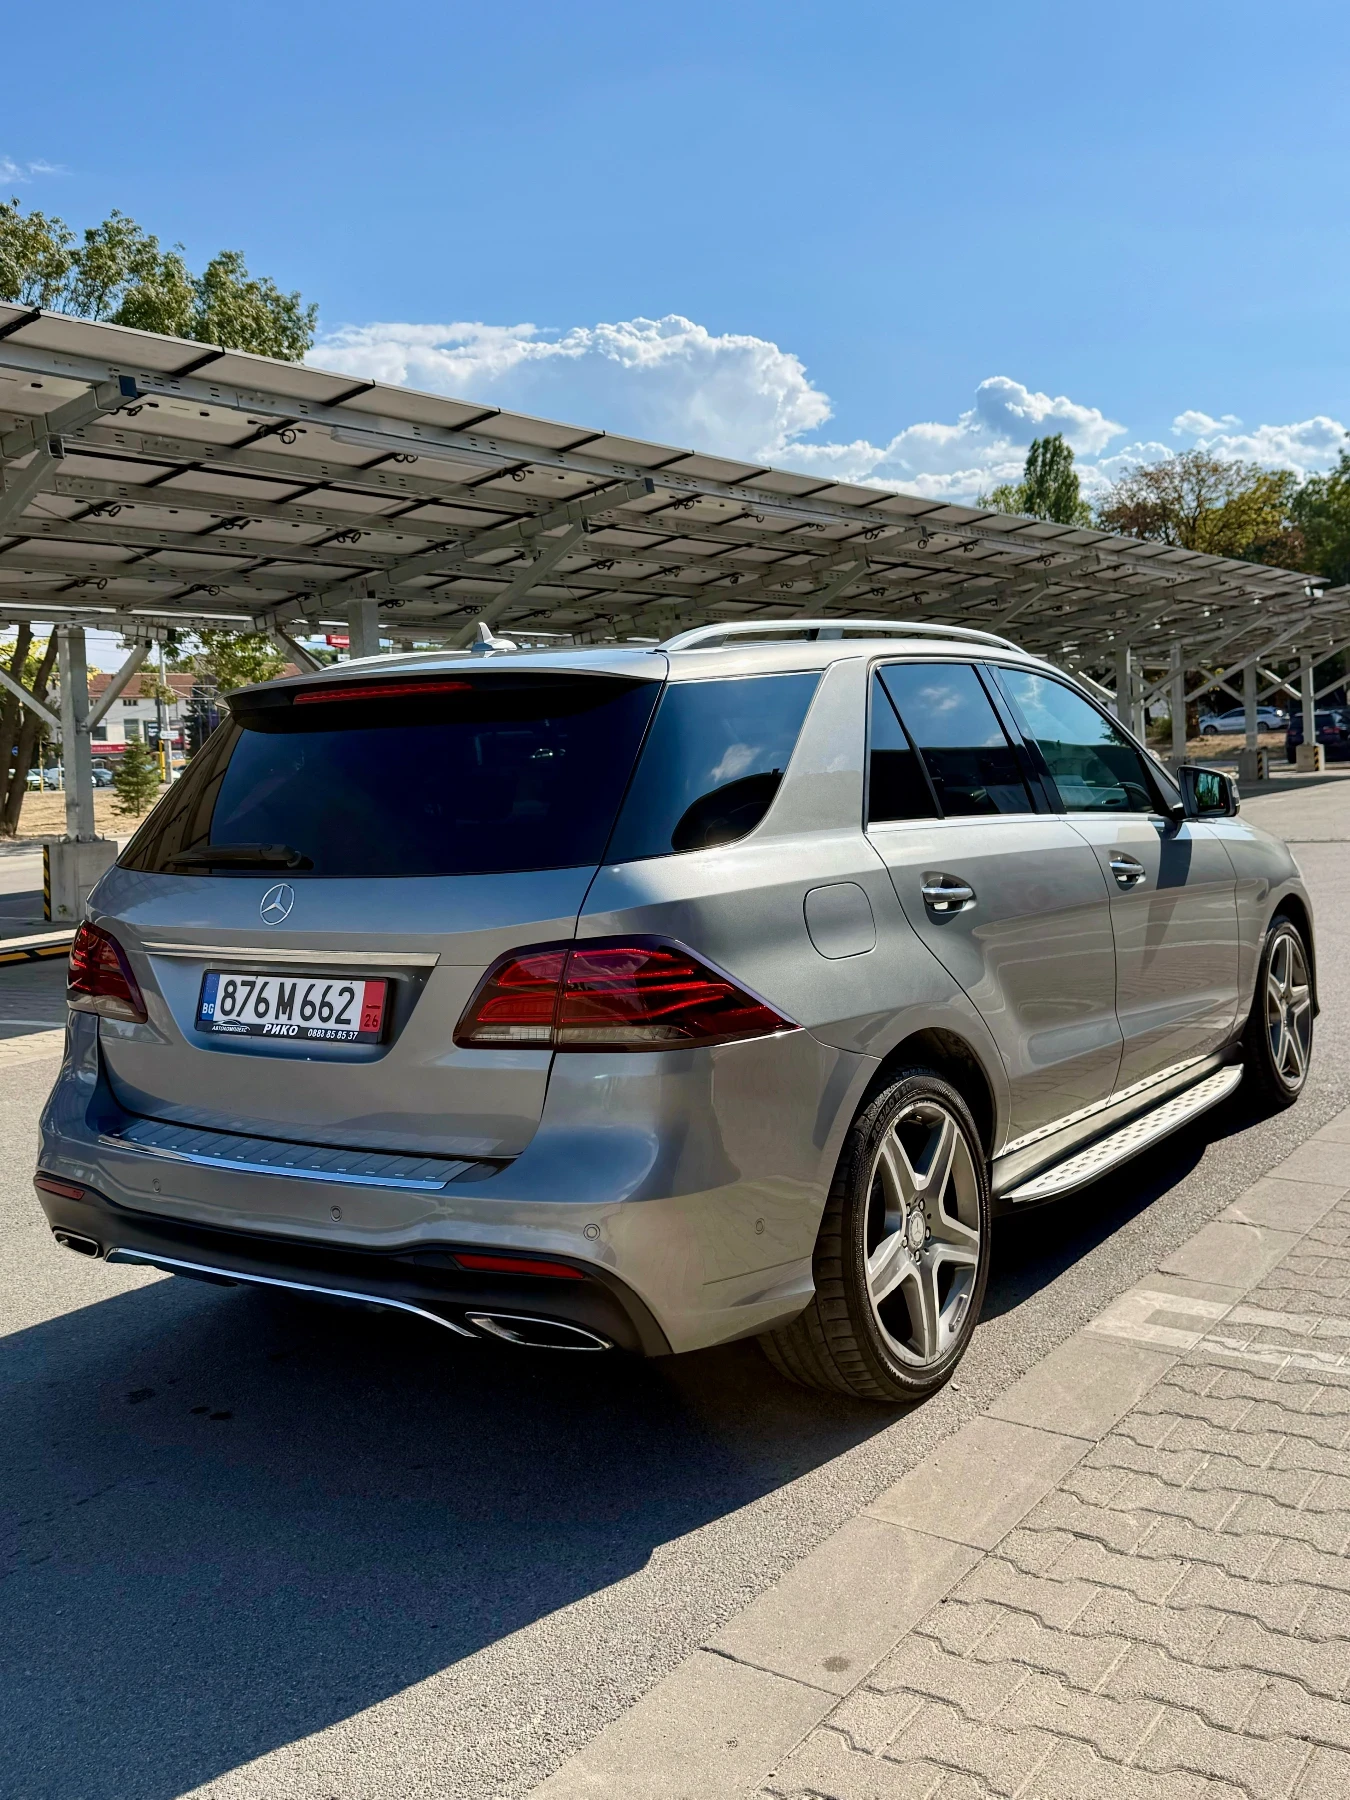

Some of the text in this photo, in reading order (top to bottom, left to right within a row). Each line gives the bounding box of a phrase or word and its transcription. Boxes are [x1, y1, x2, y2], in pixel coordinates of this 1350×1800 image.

[202, 1003, 215, 1014] BG
[363, 1013, 379, 1028] 26
[262, 1023, 299, 1036] РИКО
[326, 1030, 336, 1039] 85
[336, 1030, 347, 1040] 85
[347, 1031, 359, 1040] 37
